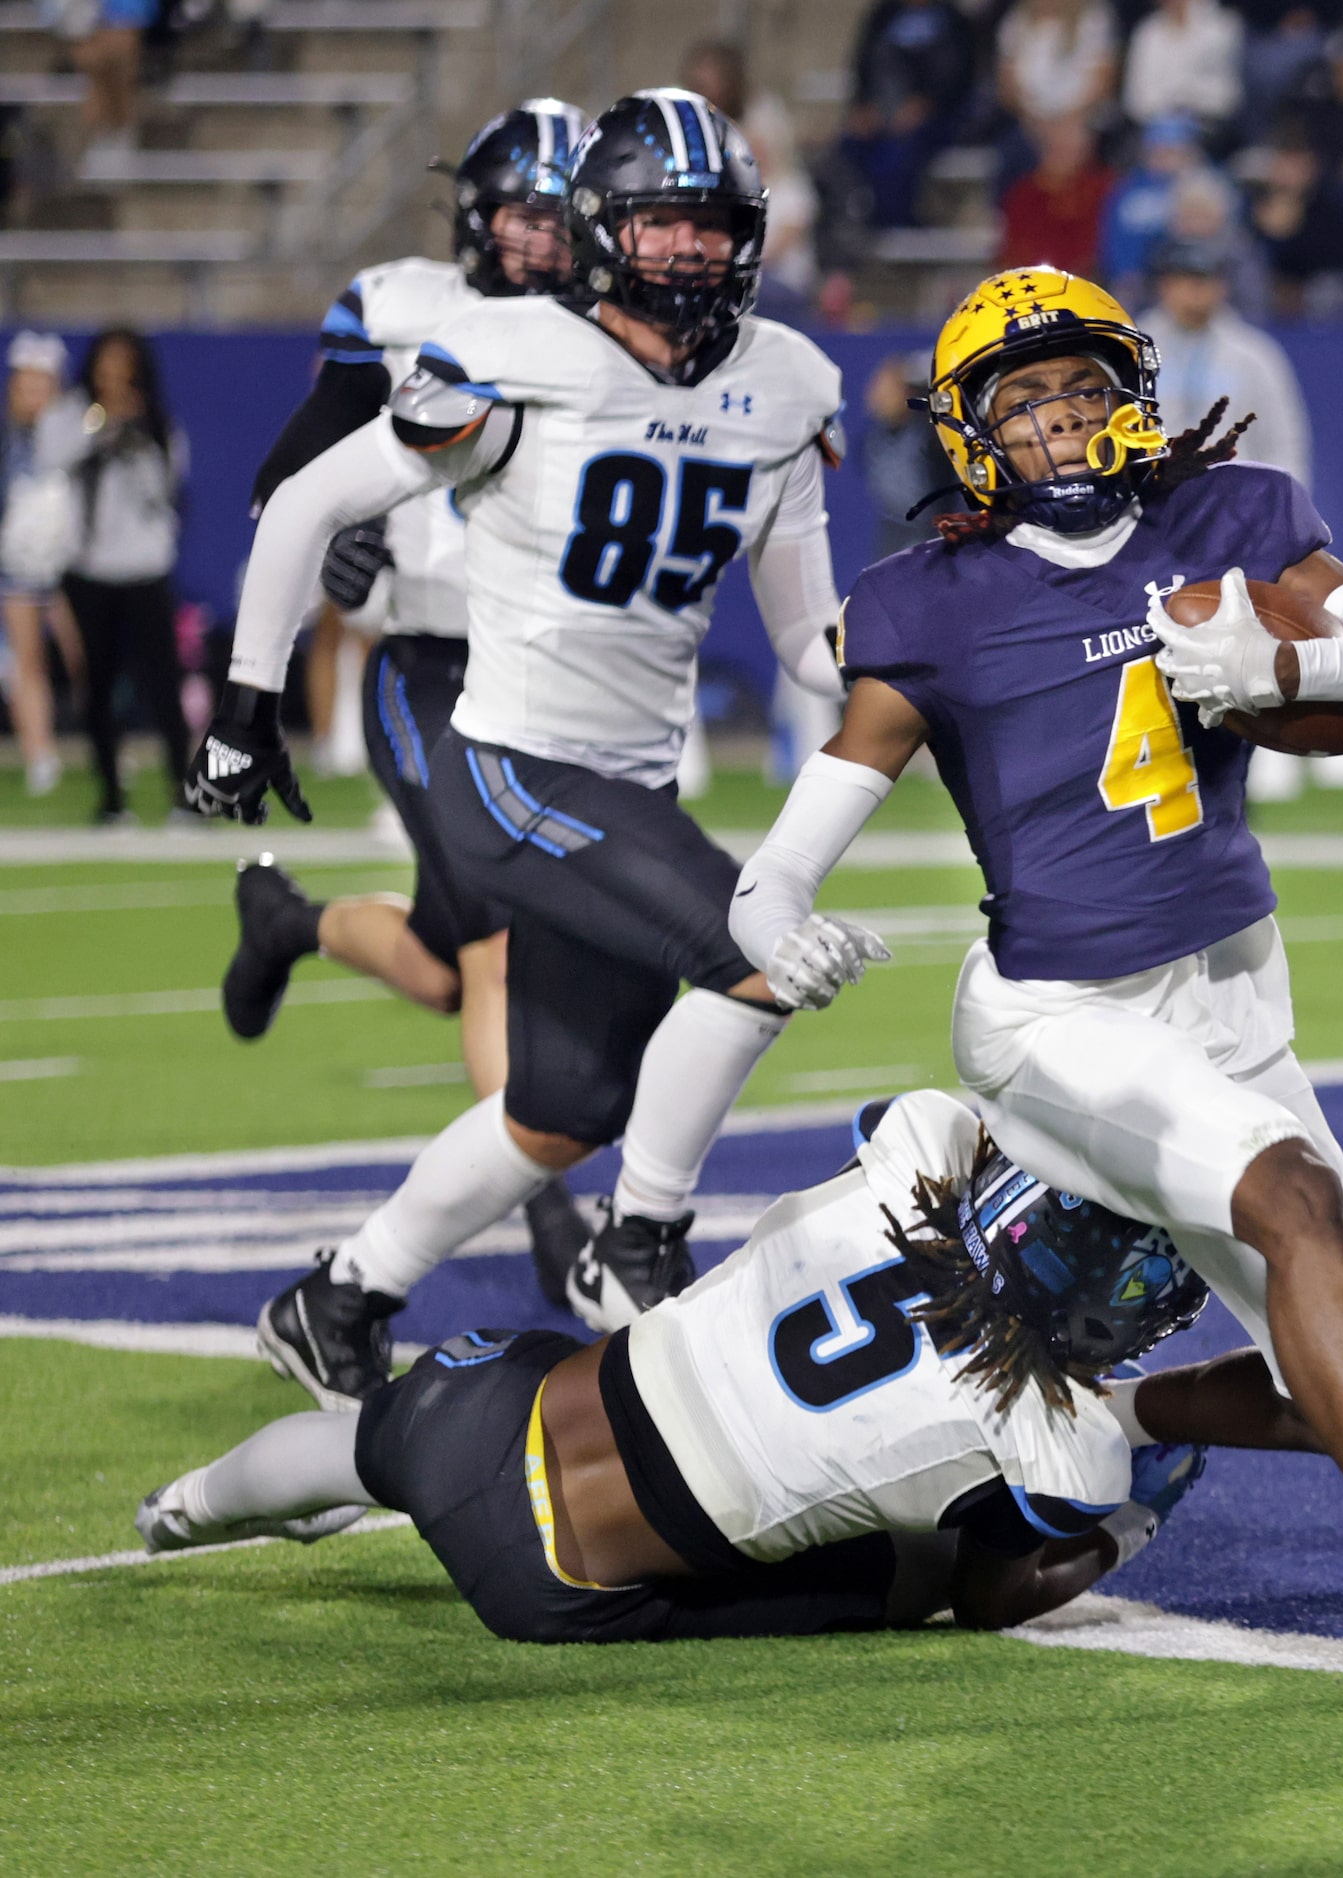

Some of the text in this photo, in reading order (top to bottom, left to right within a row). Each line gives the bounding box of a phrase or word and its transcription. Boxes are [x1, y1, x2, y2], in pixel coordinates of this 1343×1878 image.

[1017, 311, 1059, 330] GRIT
[559, 450, 753, 611] 85
[1052, 485, 1094, 498] Riddell
[1082, 624, 1157, 662] LIONS
[1097, 655, 1203, 843] 4
[768, 1254, 988, 1414] 5
